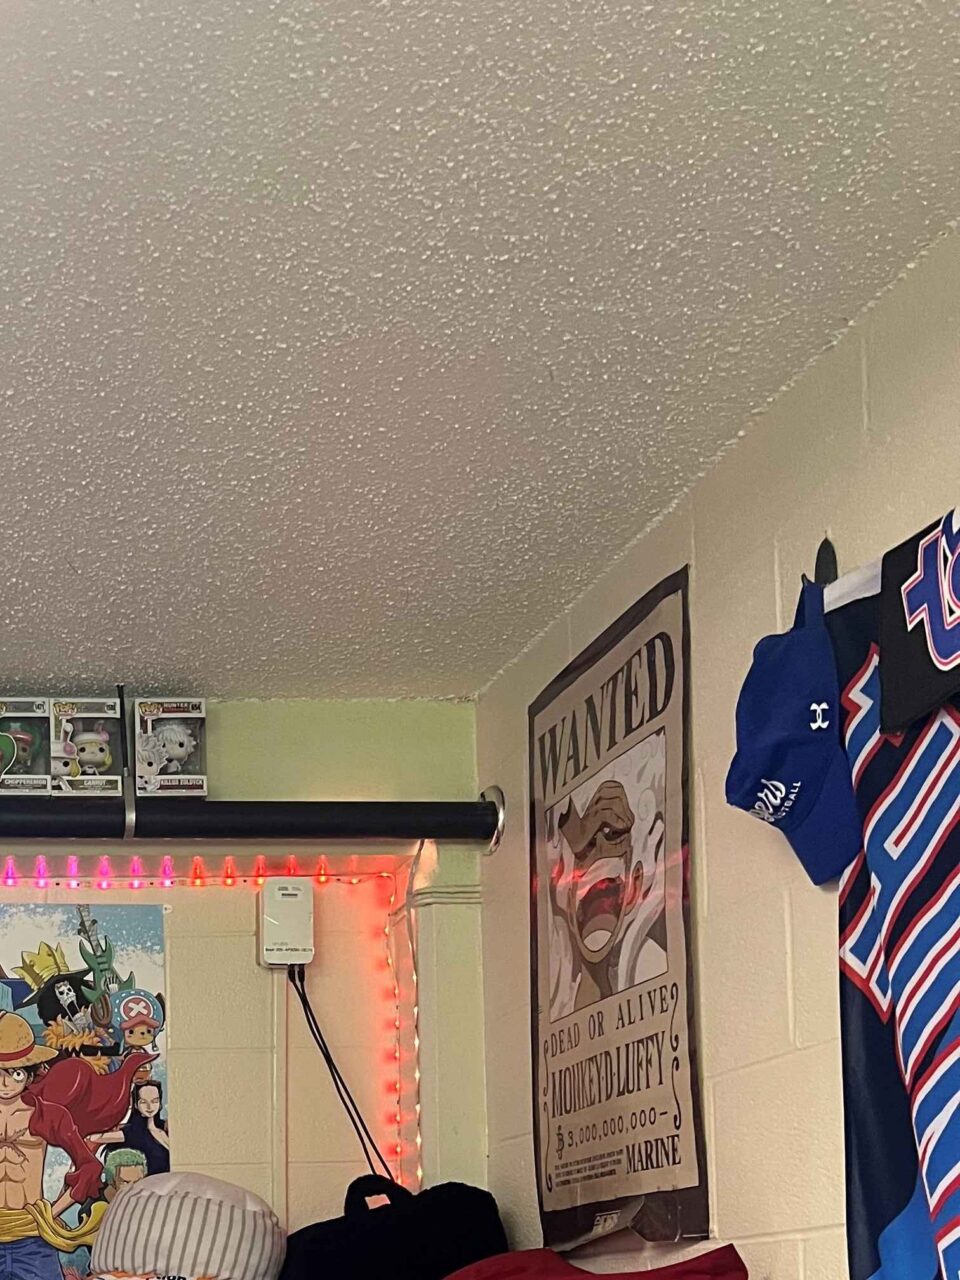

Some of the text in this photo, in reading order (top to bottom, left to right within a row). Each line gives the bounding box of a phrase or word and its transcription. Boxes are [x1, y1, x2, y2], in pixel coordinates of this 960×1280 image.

[538, 632, 675, 801] WANTED
[551, 985, 669, 1058] DEAD OR ALIVE
[625, 1134, 681, 1175] MARINE
